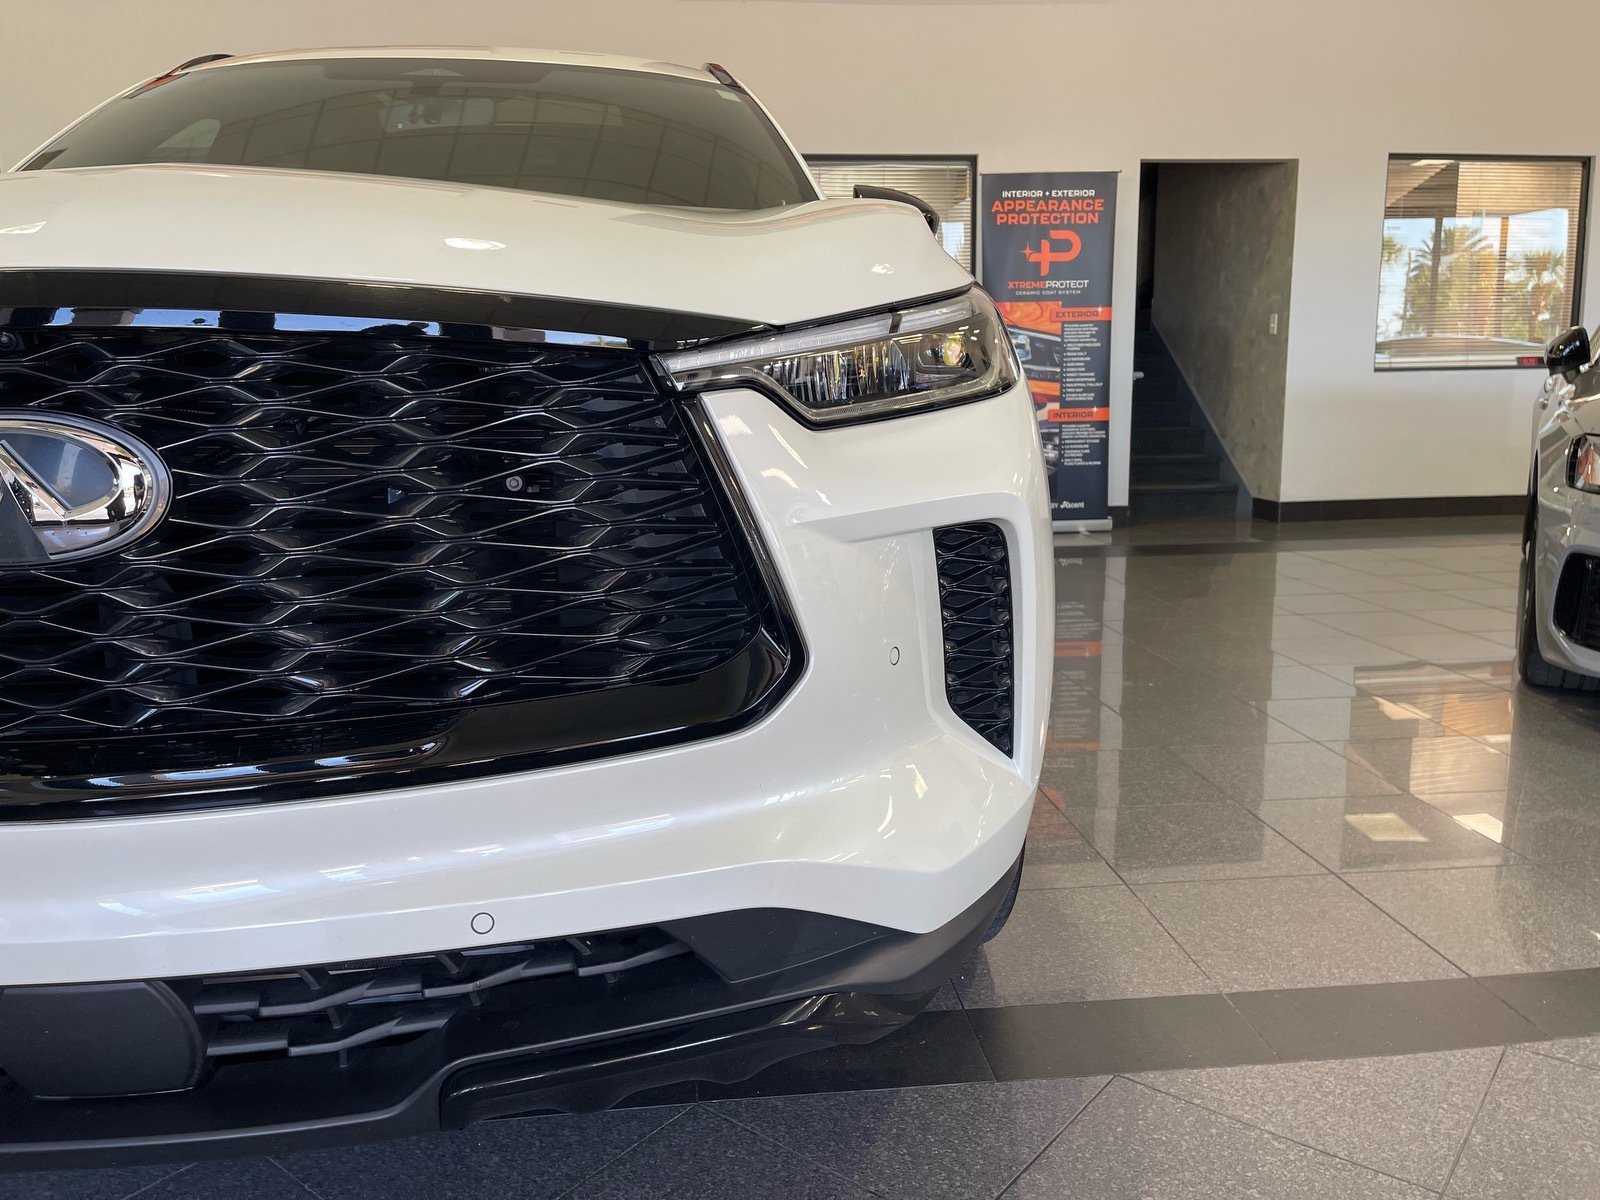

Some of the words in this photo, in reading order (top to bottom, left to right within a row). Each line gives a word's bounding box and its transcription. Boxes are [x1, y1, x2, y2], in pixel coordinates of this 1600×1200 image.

[1002, 190, 1043, 198] INTERIOR
[1051, 189, 1096, 198] EXTERIOR
[991, 199, 1105, 212] APPEARANCE
[996, 212, 1100, 225] PROTECTION
[1007, 280, 1090, 289] XTREMEPROTECT
[1055, 310, 1099, 318] EXTERIOR
[1053, 411, 1094, 419] INTERIOR
